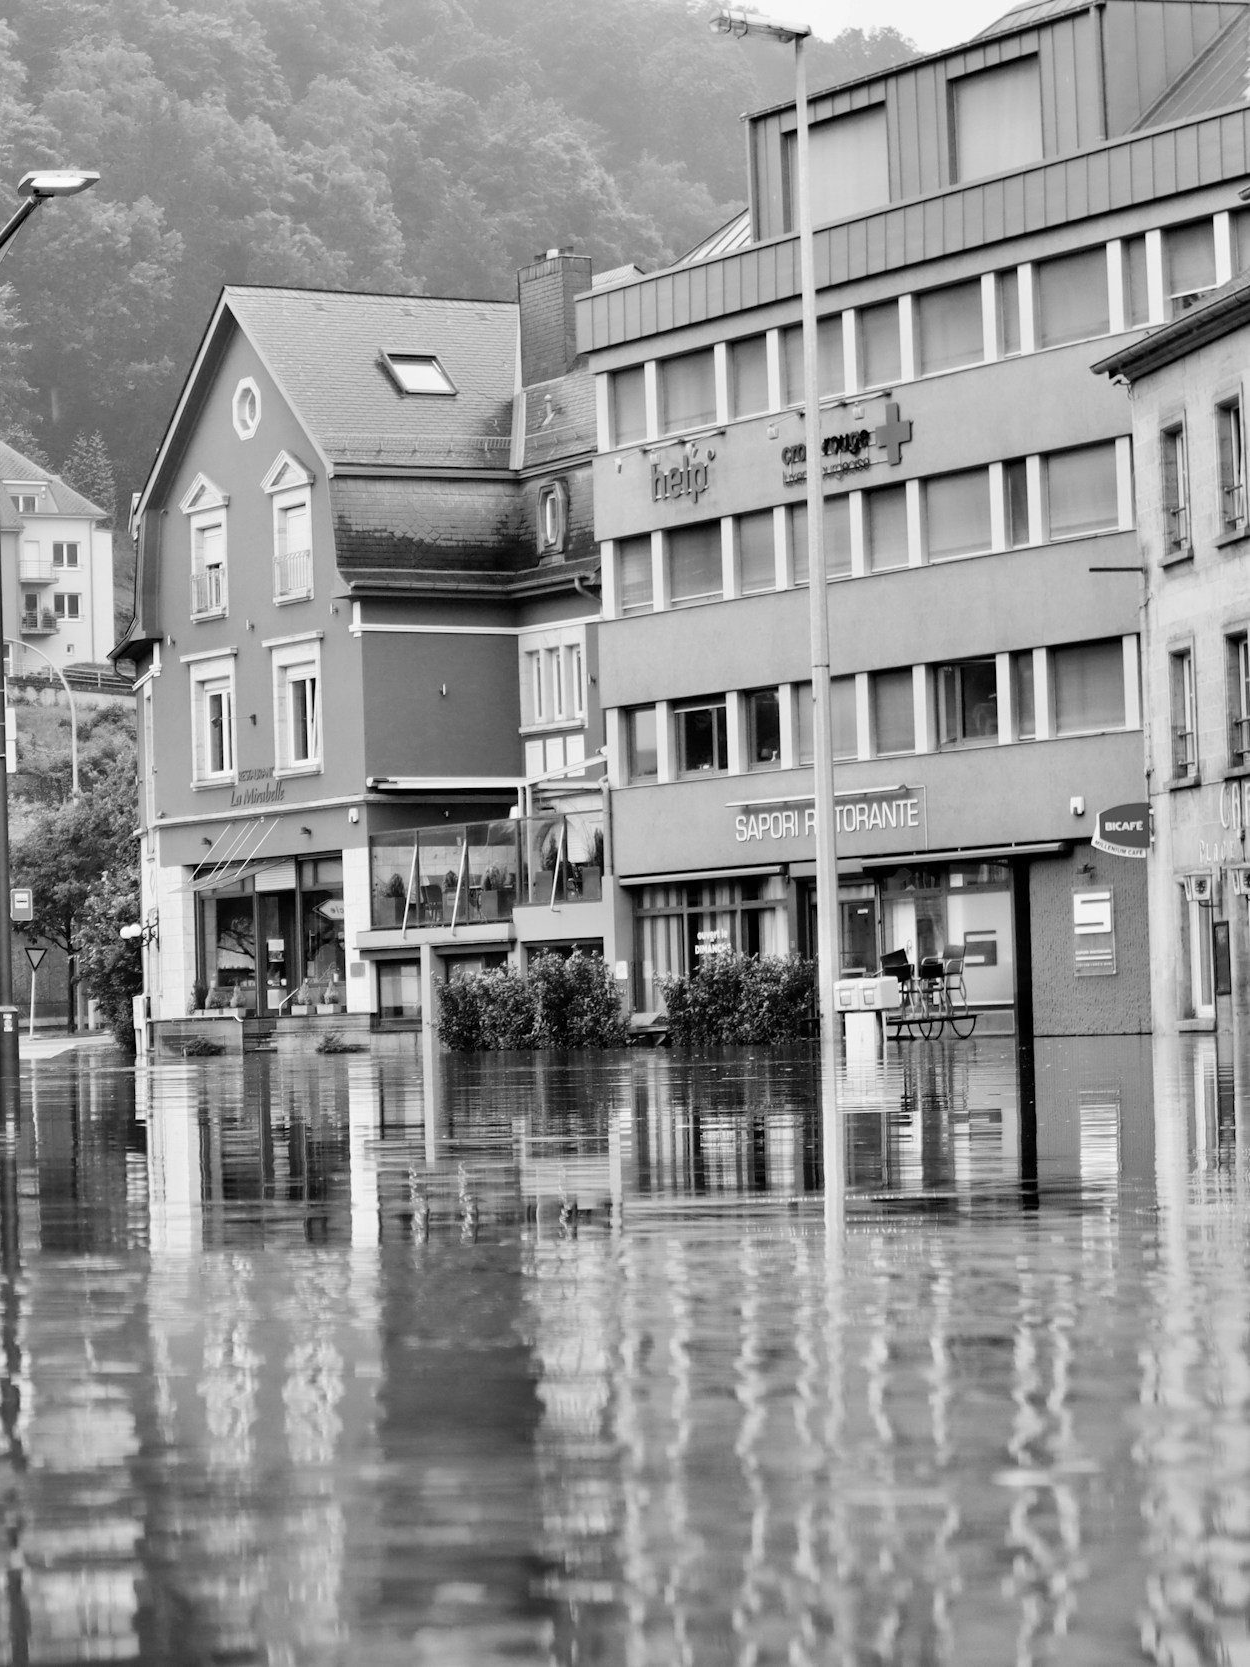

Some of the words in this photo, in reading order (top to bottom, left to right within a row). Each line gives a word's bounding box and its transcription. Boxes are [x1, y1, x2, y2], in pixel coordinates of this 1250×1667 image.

[650, 453, 710, 504] help
[230, 790, 243, 807] La
[243, 781, 285, 806] Mirabelle
[735, 809, 800, 842] SAPORI
[805, 798, 920, 836] RTORANTE
